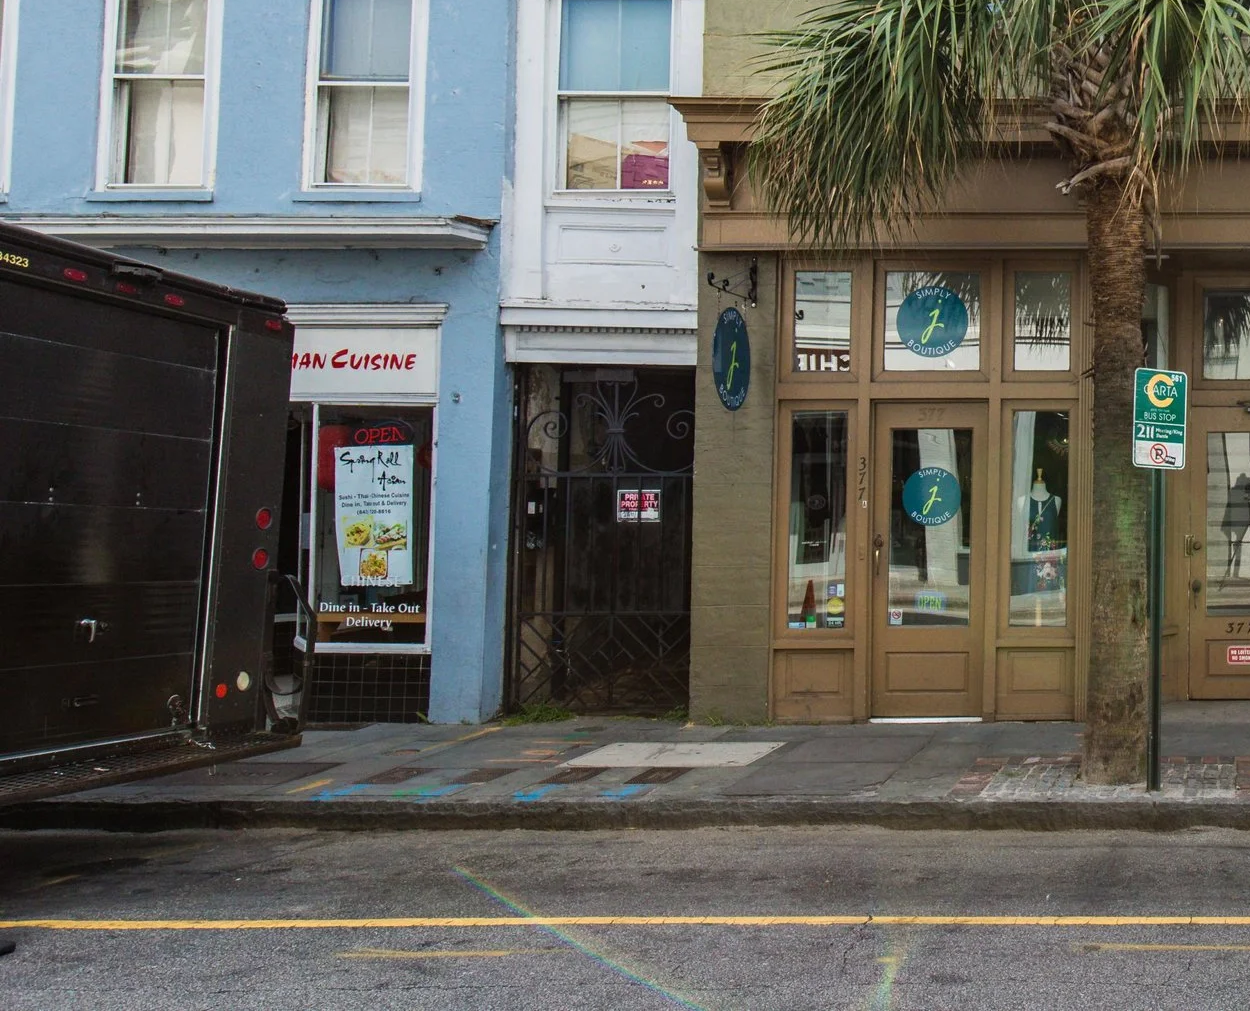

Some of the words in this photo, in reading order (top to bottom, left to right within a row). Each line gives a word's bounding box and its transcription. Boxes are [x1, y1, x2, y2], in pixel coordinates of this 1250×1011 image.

[916, 289, 952, 300] SIMPLY
[907, 339, 957, 356] BOUTIQUE
[292, 353, 327, 370] IAN
[331, 349, 417, 370] CUISINE
[1143, 411, 1157, 420] BUS
[1158, 413, 1177, 422] STOP
[354, 426, 406, 444] OPEN
[1136, 424, 1155, 439] 211
[377, 450, 402, 468] Roll
[858, 457, 866, 501] 377
[919, 468, 948, 478] SIMPLY
[624, 493, 655, 501] PRIATE
[911, 511, 952, 524] BOUTIQUE
[320, 602, 346, 612] Dine
[349, 602, 360, 612] in
[370, 602, 395, 613] Take
[398, 603, 421, 613] Out
[346, 616, 392, 628] Delivery
